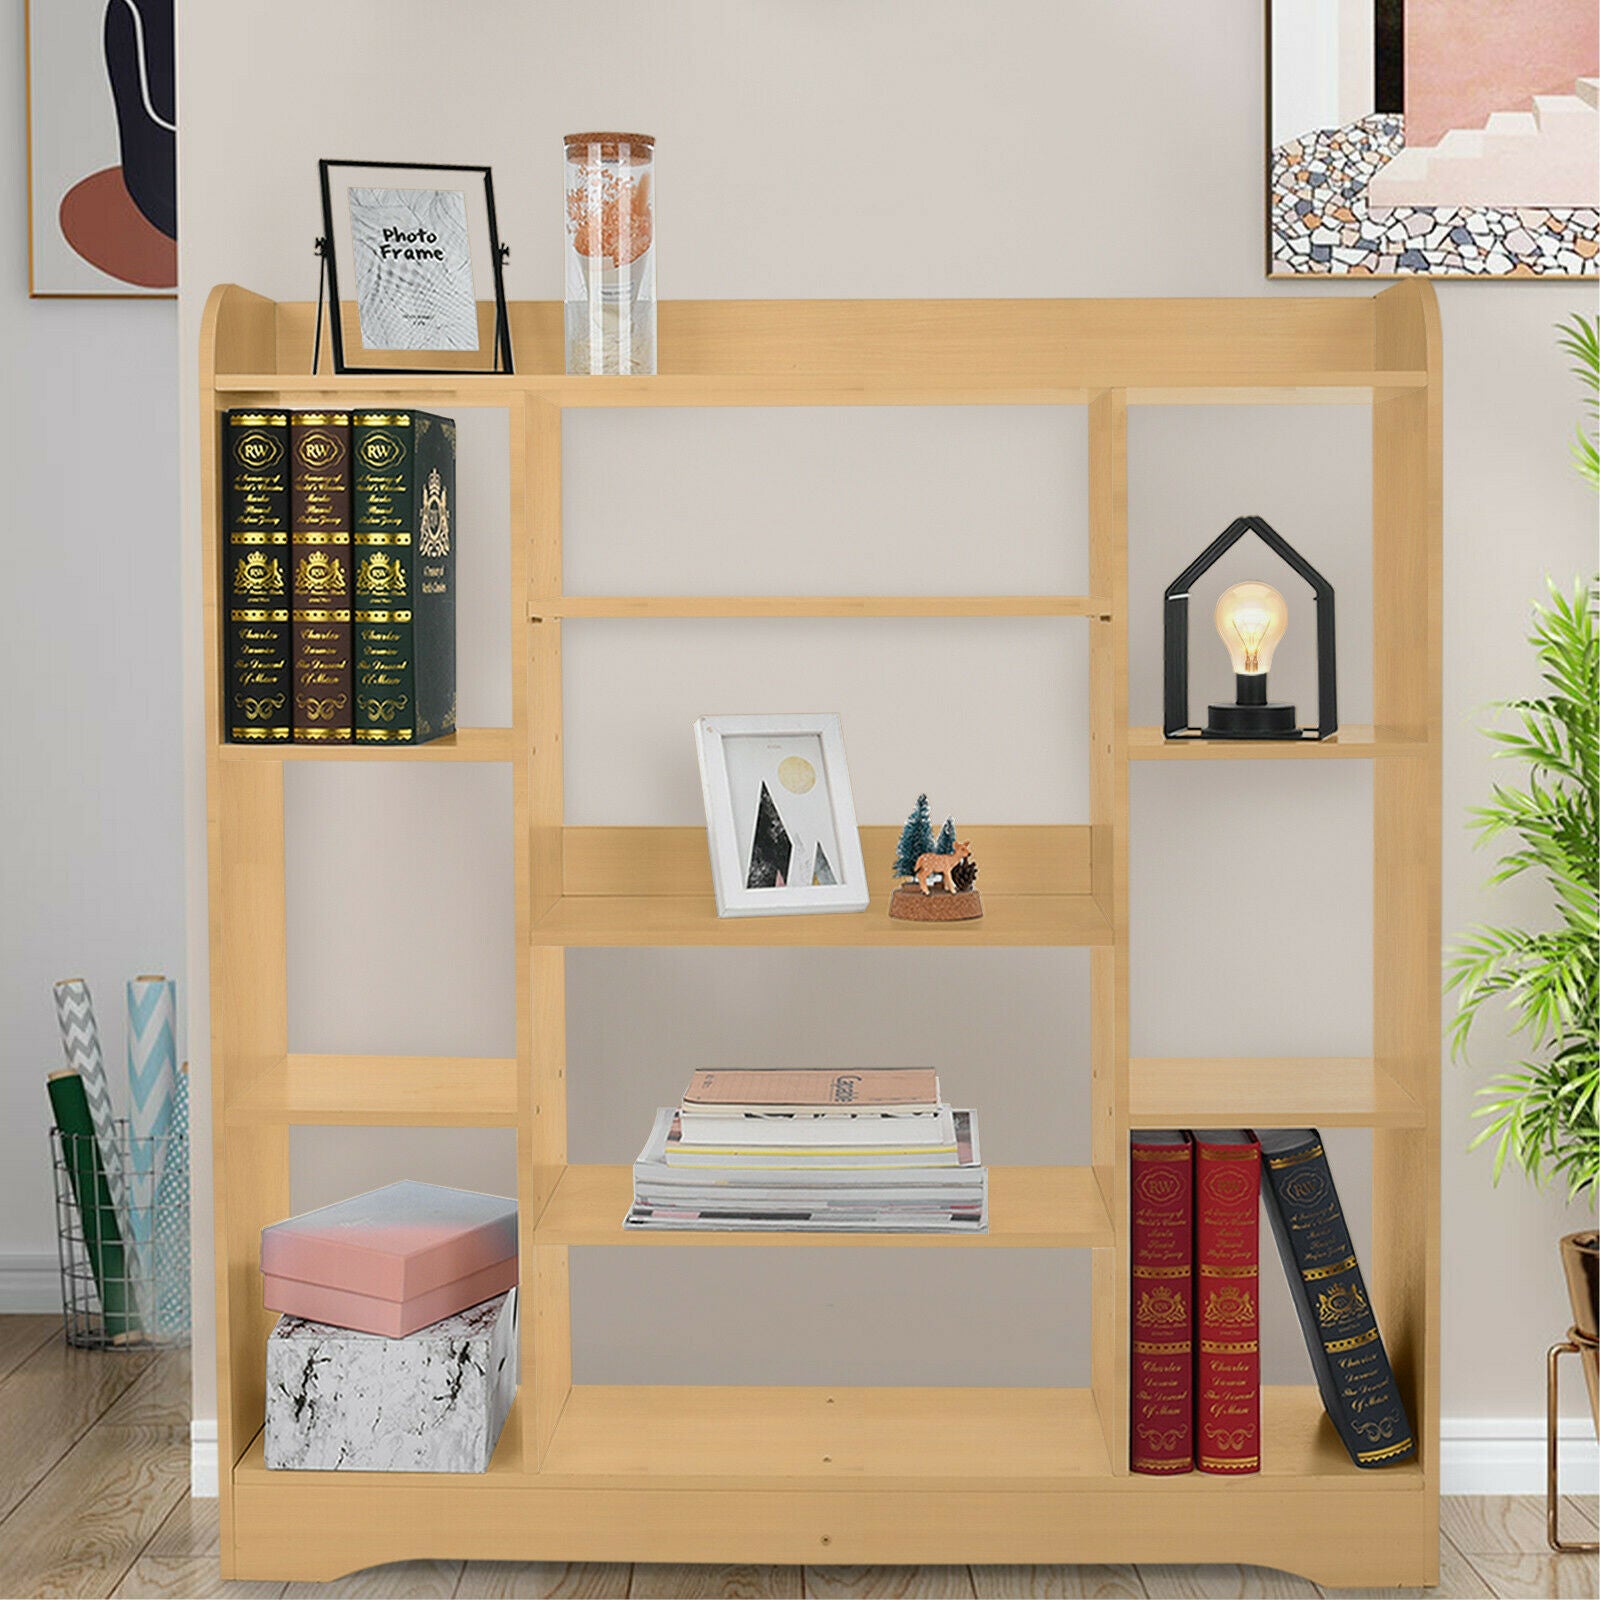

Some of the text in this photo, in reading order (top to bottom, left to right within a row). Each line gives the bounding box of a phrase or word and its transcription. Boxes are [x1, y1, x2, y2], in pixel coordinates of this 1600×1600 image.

[382, 226, 438, 243] Photo
[380, 244, 444, 261] Frame
[245, 444, 269, 459] RW
[306, 444, 330, 459] RW
[367, 444, 391, 459] RW
[1149, 1180, 1174, 1194] RW
[1142, 1361, 1182, 1373] Charles
[1210, 1361, 1250, 1372] Charles
